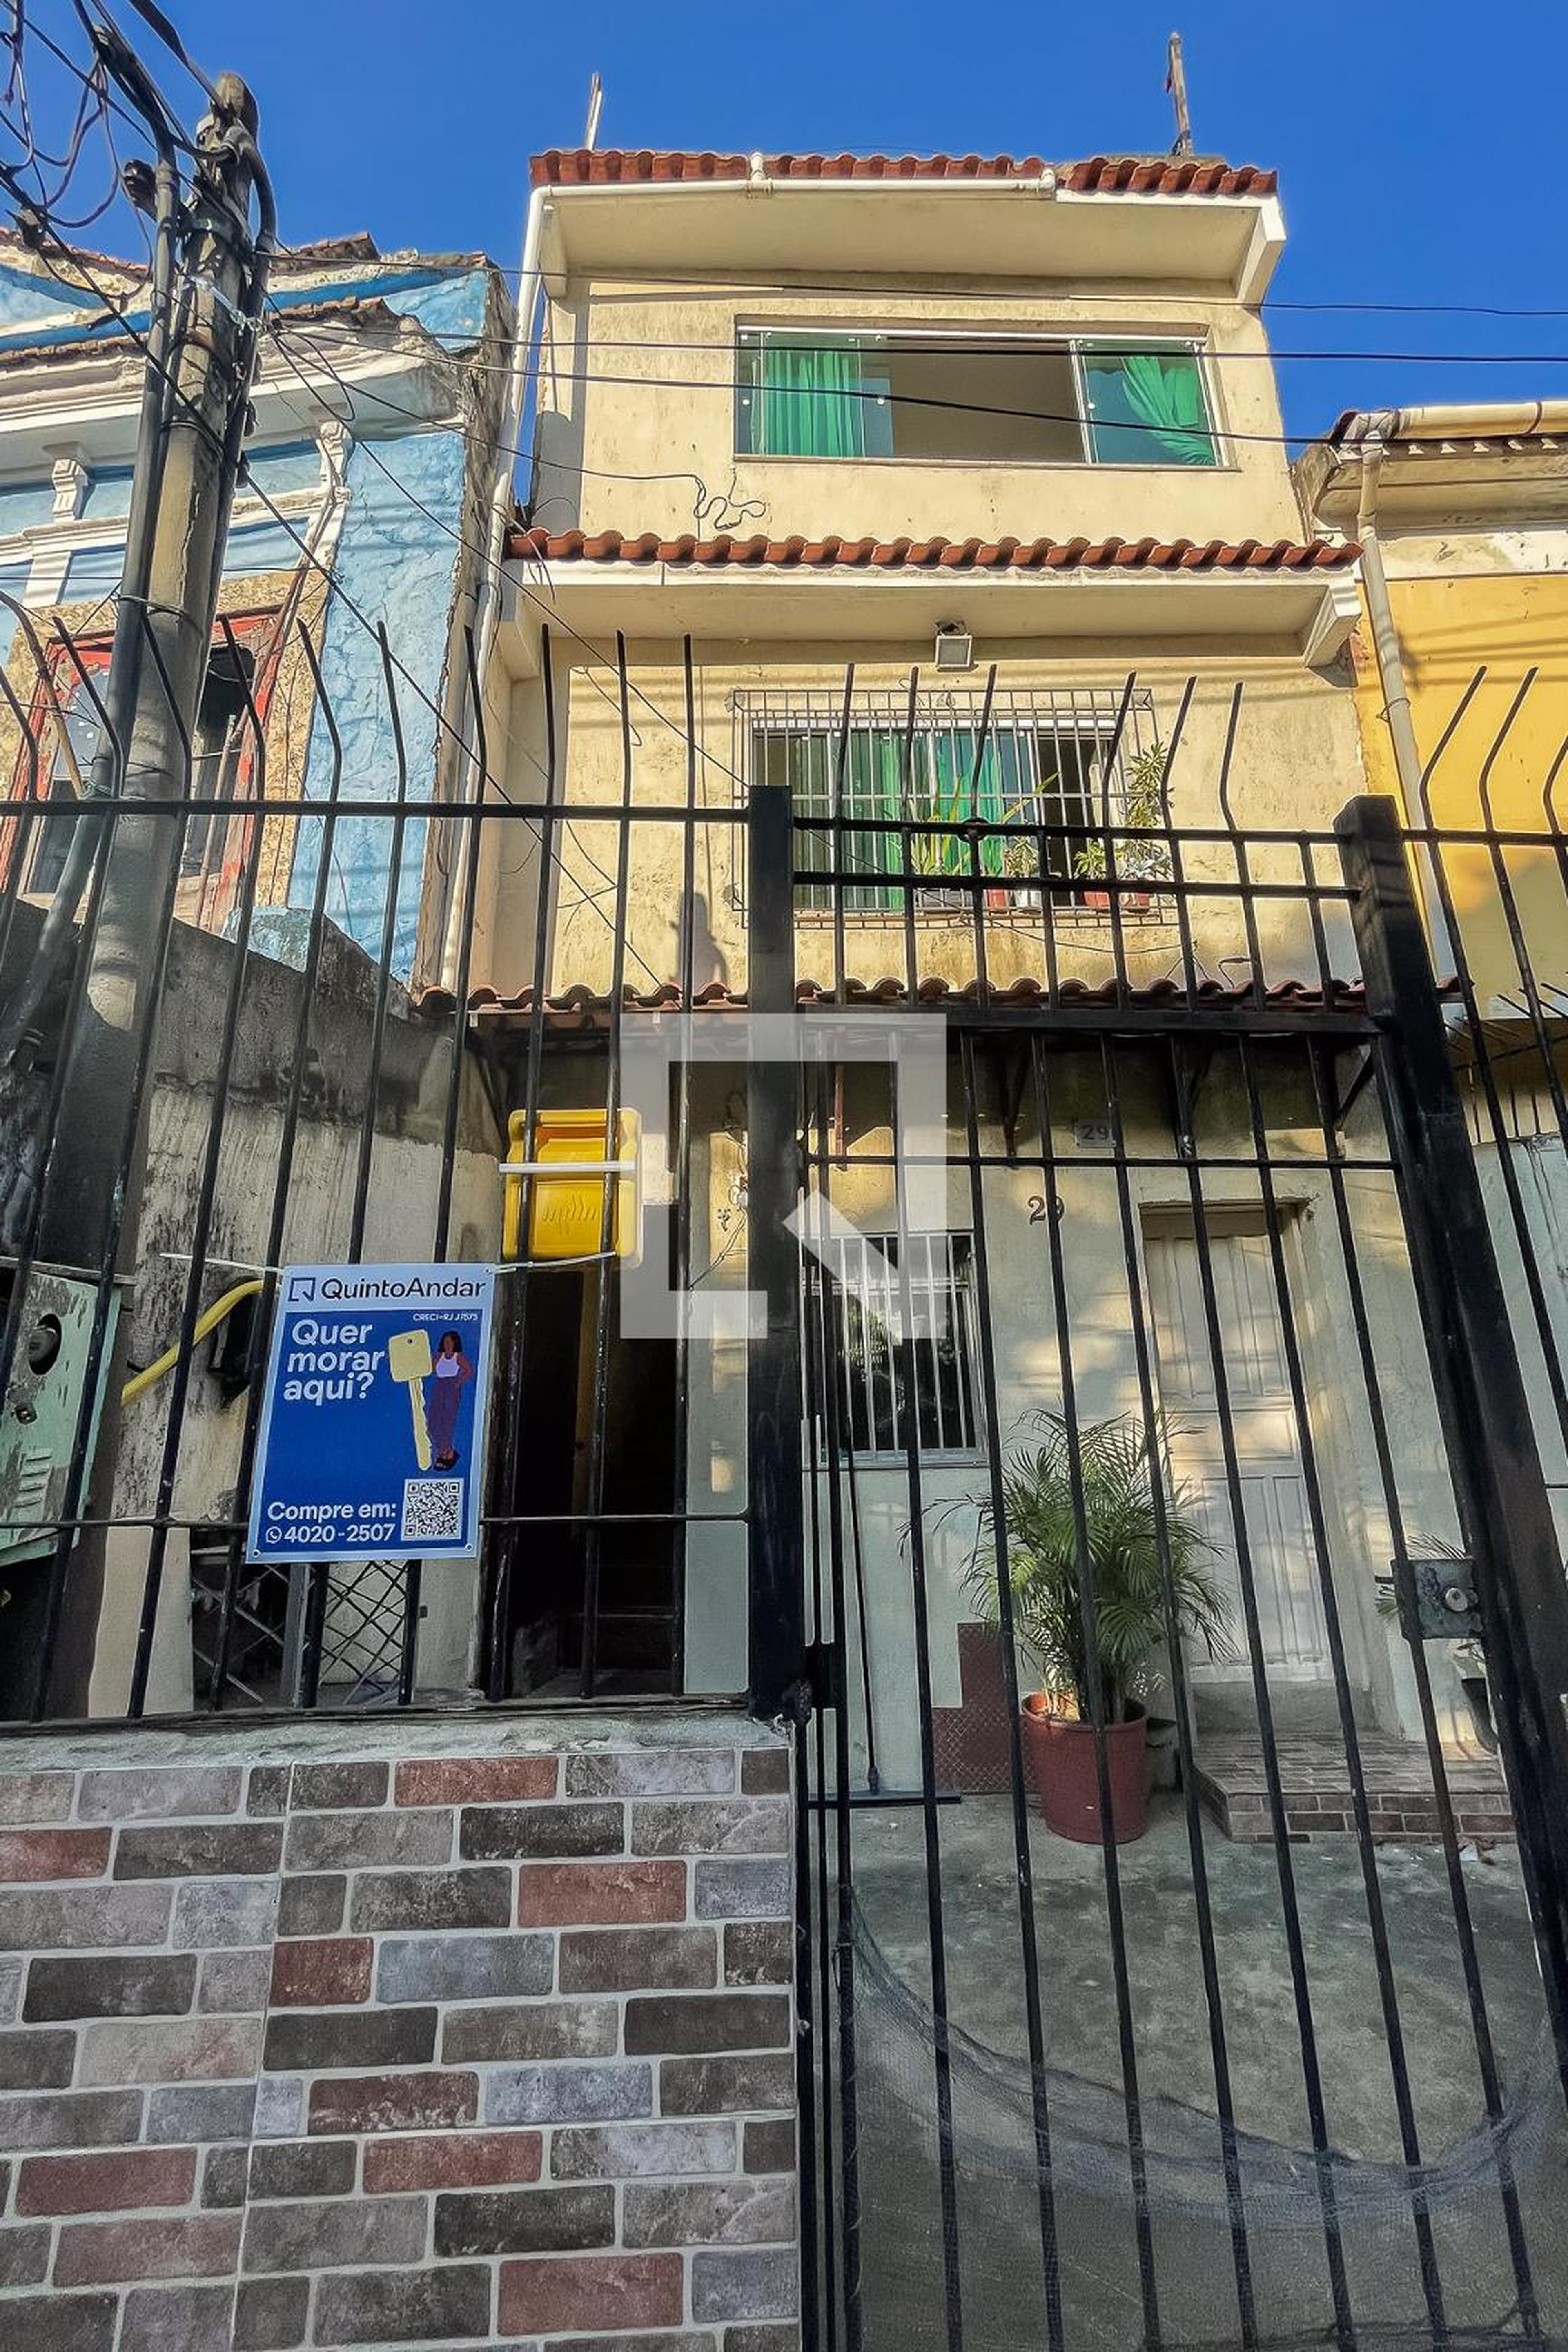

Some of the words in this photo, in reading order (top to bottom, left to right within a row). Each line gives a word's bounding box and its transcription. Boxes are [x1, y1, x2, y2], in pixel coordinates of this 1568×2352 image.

[1080, 1125, 1107, 1140] 29
[321, 1277, 486, 1301] QuintoAndar
[292, 1319, 372, 1345] Quer
[287, 1351, 385, 1372] morar
[283, 1372, 374, 1406] aqui?
[267, 1501, 354, 1523] Compre
[358, 1503, 396, 1518] em:
[284, 1523, 395, 1543] 4020-2507
